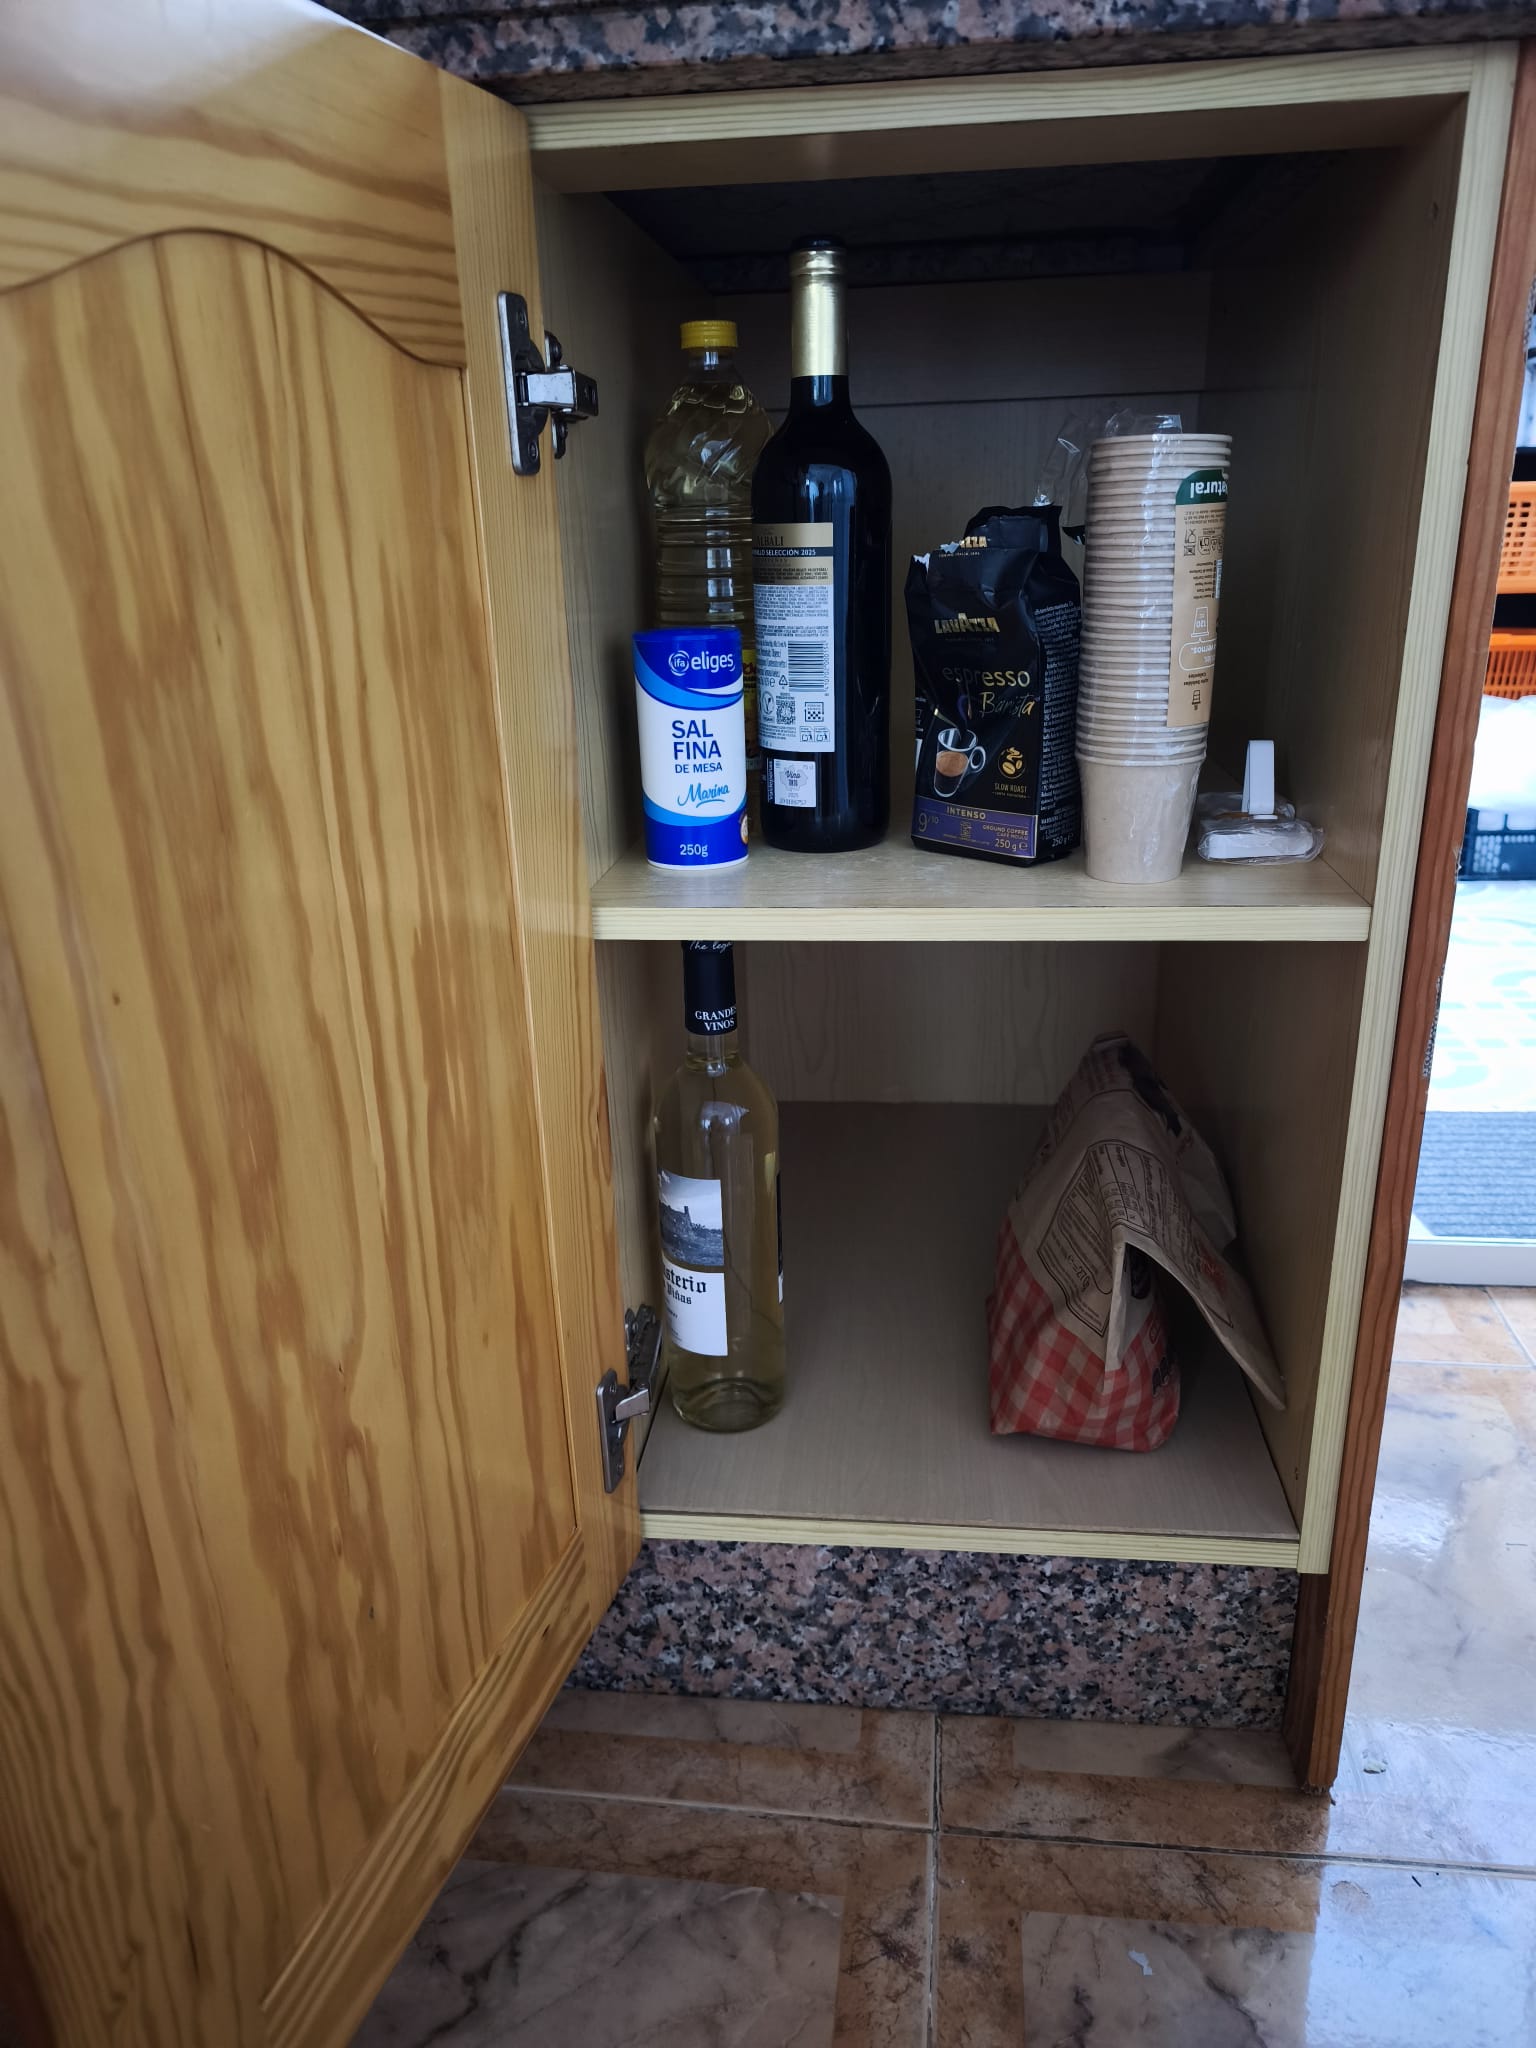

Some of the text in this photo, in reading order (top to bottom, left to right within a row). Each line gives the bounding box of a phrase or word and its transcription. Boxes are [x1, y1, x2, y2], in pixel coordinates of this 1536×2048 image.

[933, 612, 1001, 634] LAVAZZA
[691, 652, 735, 674] eliges
[942, 666, 1031, 688] espresso
[671, 719, 714, 739] SAL
[673, 739, 722, 761] FINA
[675, 762, 723, 774] DE MESA
[678, 782, 731, 807] Marina
[946, 805, 986, 820] INTENSO
[679, 843, 709, 858] 250g
[994, 838, 1011, 849] 250
[704, 1016, 735, 1032] VINOS
[663, 1266, 707, 1293] sterio
